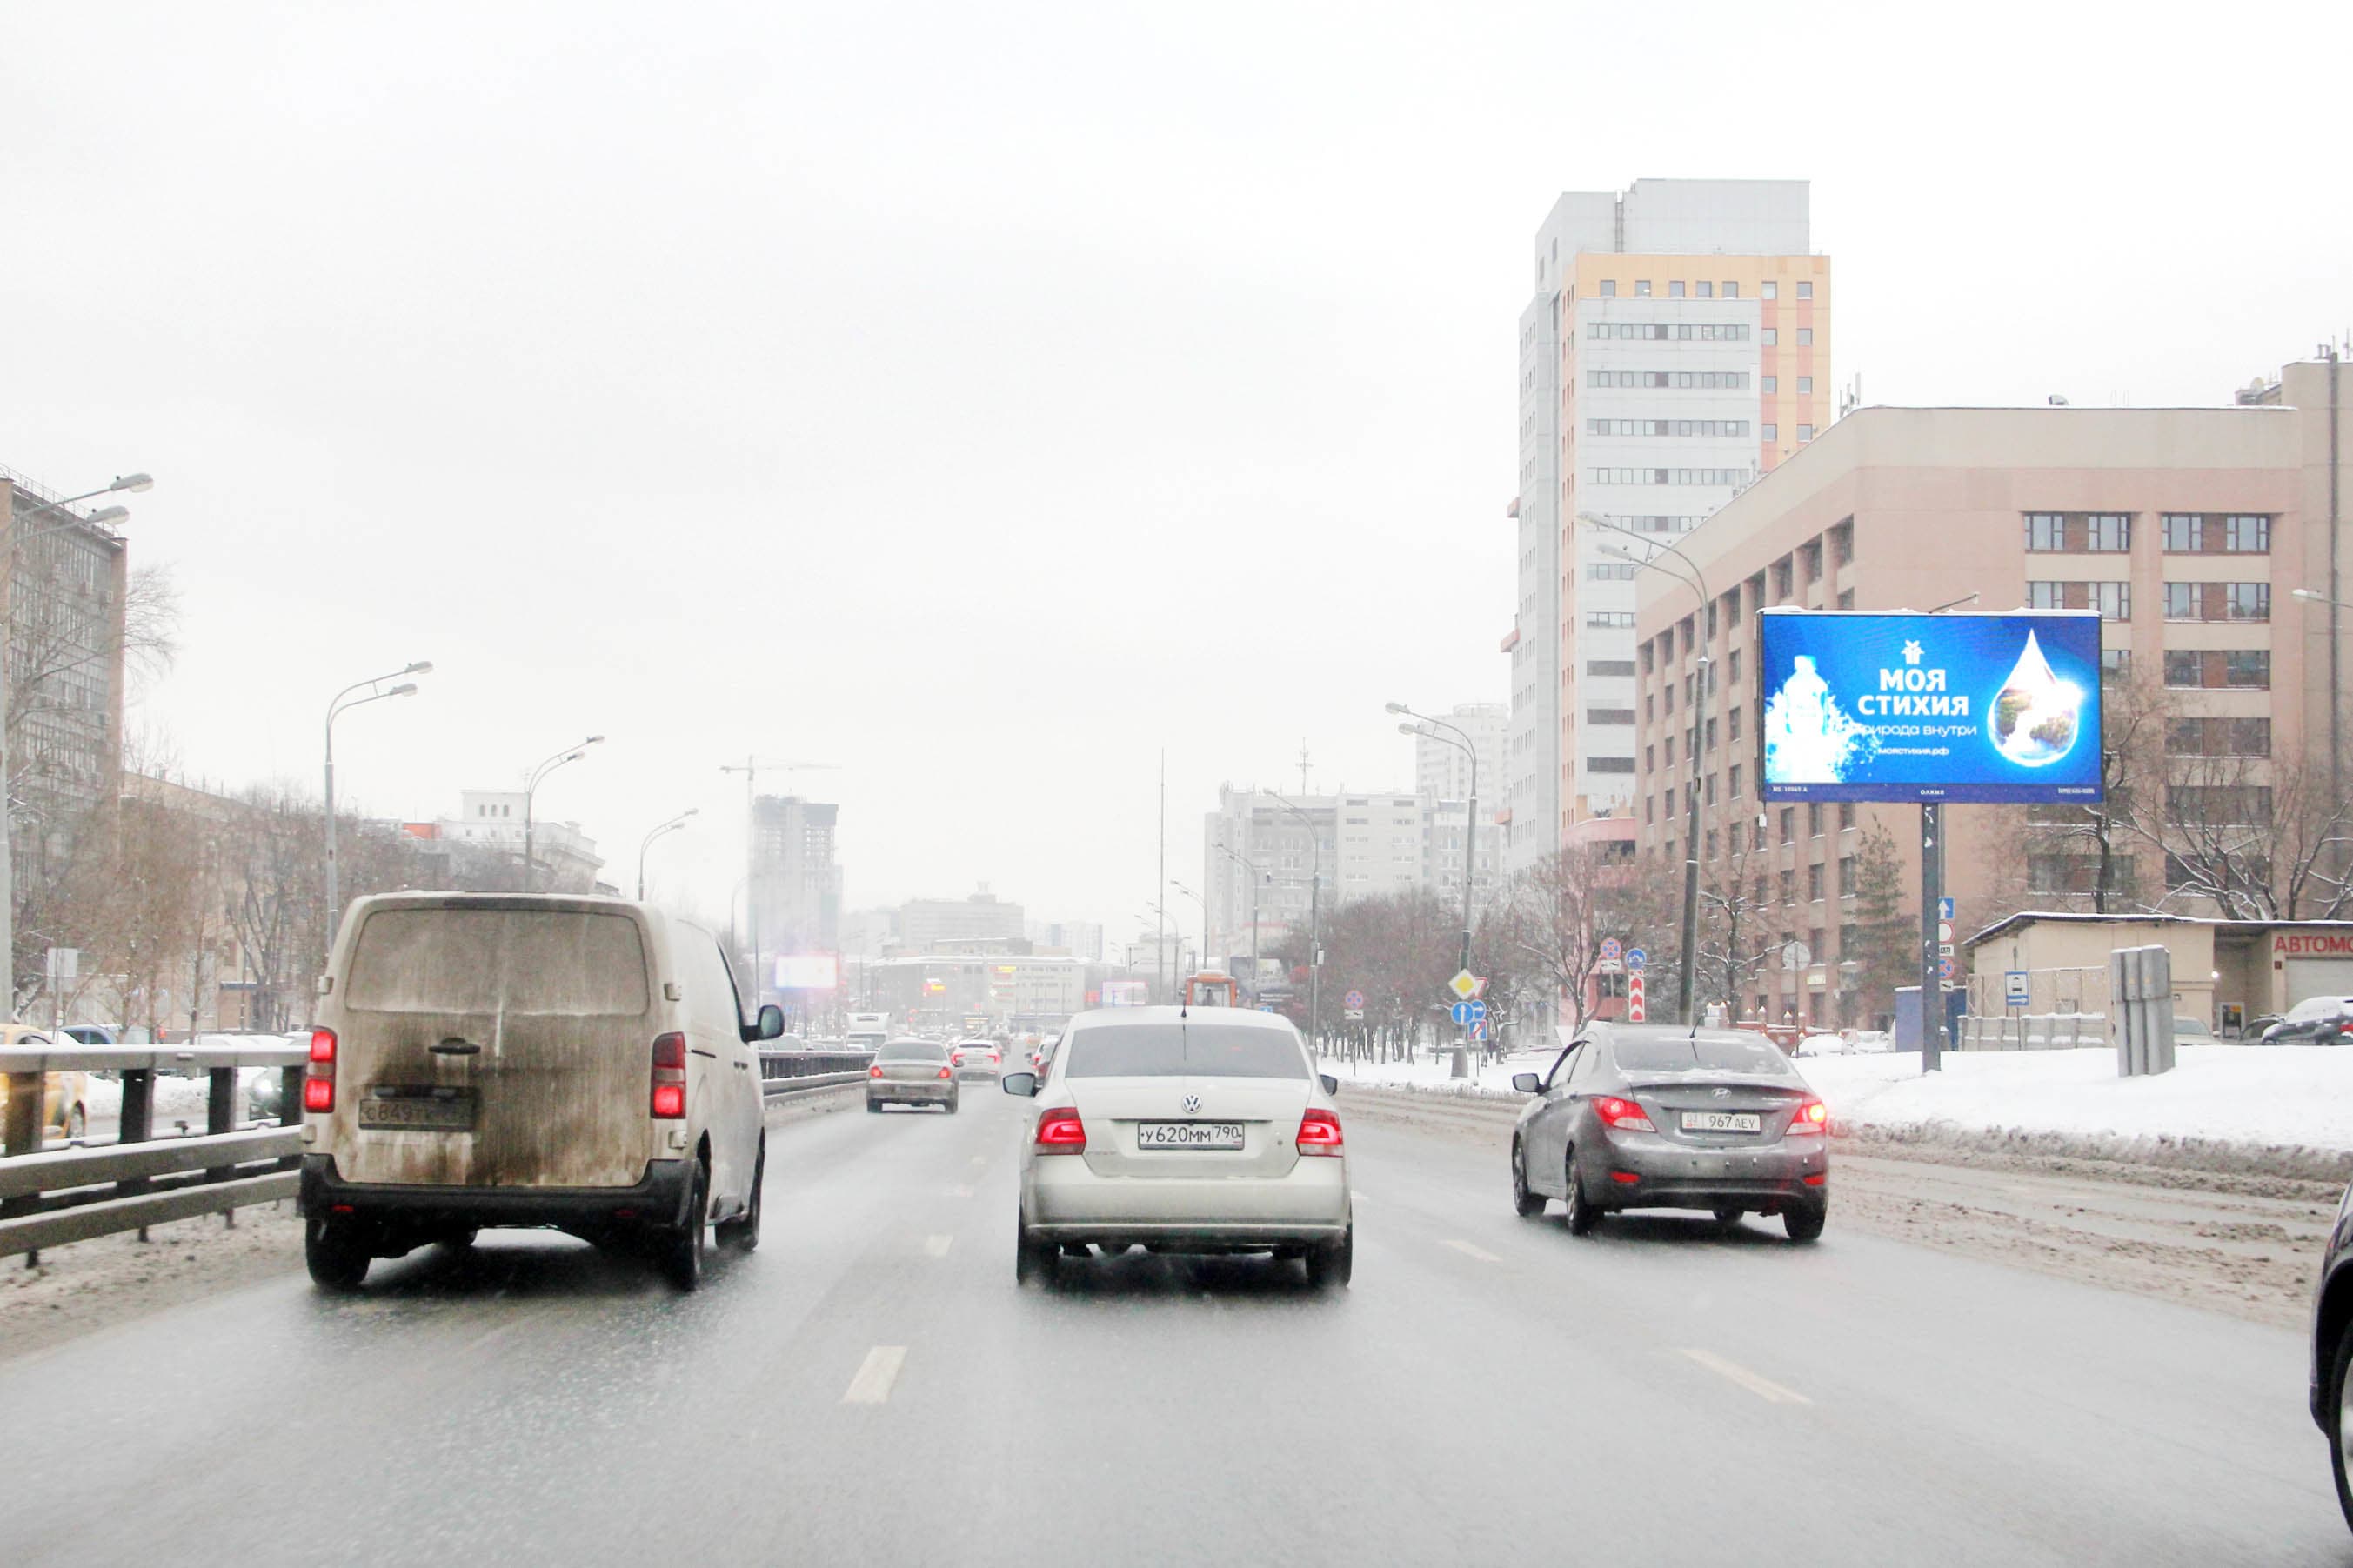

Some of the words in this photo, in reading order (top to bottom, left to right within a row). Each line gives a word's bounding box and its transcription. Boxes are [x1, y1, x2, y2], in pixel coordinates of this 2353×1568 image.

[1879, 668, 1947, 691] МОЯ
[1857, 695, 1969, 716] СТИХИЯ
[1855, 725, 1920, 737] рирода
[1923, 725, 1977, 737] внутри
[1877, 746, 1949, 756] моястихия.рф
[1708, 1115, 1732, 1128] 967
[1735, 1118, 1755, 1129] AEY
[1145, 1126, 1212, 1143] У620ММ
[1213, 1125, 1240, 1139] 790
